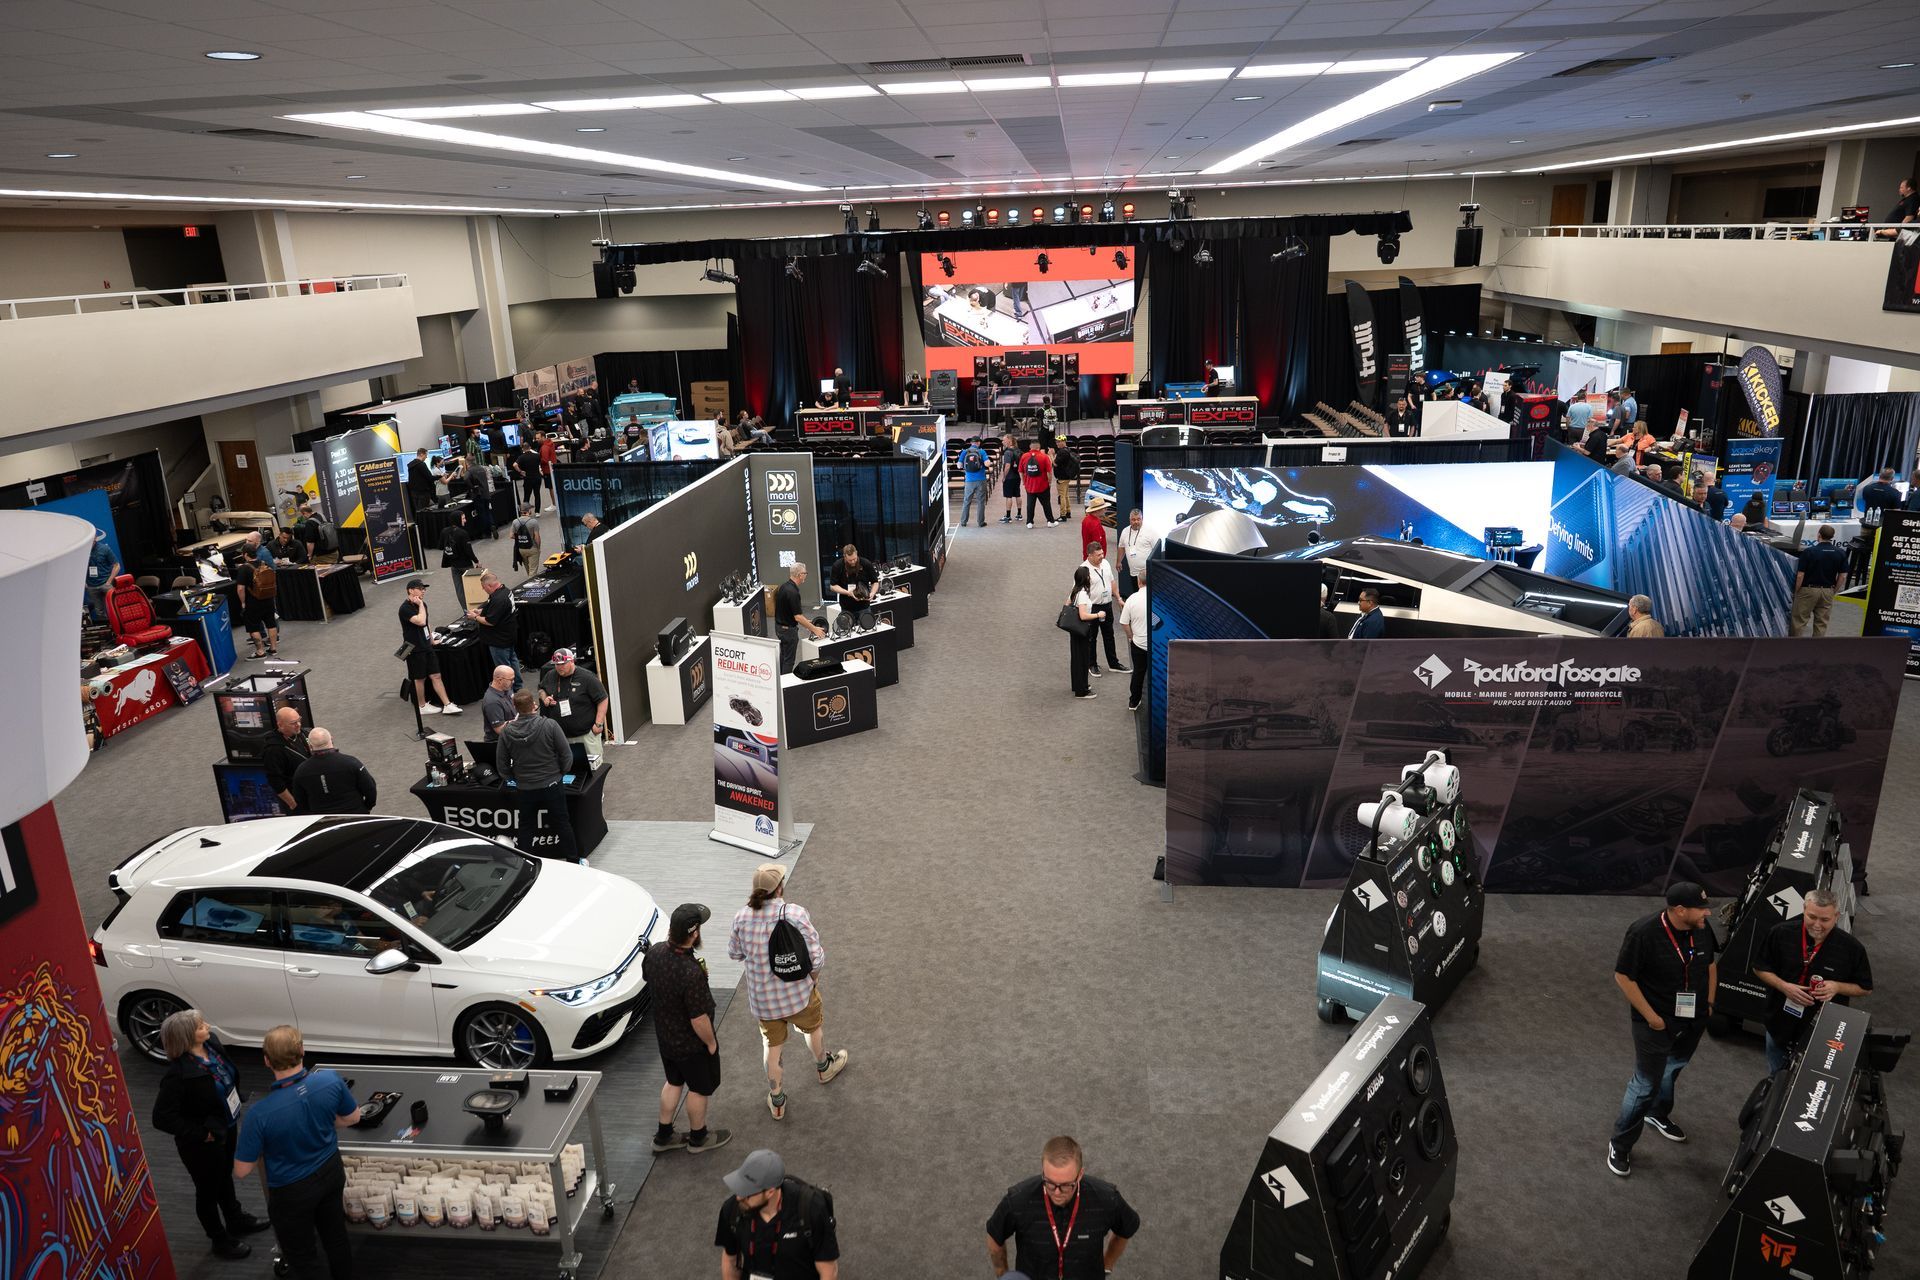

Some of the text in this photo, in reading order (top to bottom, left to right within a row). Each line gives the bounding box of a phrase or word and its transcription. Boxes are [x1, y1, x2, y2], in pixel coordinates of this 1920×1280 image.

[1354, 320, 1377, 378] trulli
[1404, 316, 1424, 372] trulli
[1749, 371, 1780, 431] KICKER
[1191, 411, 1254, 421] EXPO
[804, 421, 855, 432] EXPO
[1527, 421, 1551, 429] SINCE
[339, 468, 347, 478] 3D
[359, 461, 394, 472] CAMaster
[563, 476, 622, 491] audisn
[744, 467, 752, 512] MUSIC
[769, 491, 797, 501] morel
[771, 508, 798, 526] 50
[1547, 514, 1594, 562] Defying limits
[375, 556, 412, 568] MASTERTECH
[376, 560, 413, 575] EXPO
[1878, 608, 1917, 619] Learn Cool
[1880, 614, 1895, 622] Win
[1897, 616, 1913, 625] Cool
[714, 646, 746, 661] ESCORT
[1463, 657, 1643, 688] Rockford Fosgate
[816, 694, 847, 718] 50
[717, 779, 726, 787] THE
[726, 782, 746, 793] DRIVING
[729, 790, 775, 811] AWAKENED
[755, 825, 775, 837] MSC
[1738, 981, 1767, 992] PURPOSE
[1834, 1020, 1847, 1042] ROCKY
[1823, 1047, 1837, 1071] RIDGE
[1367, 1075, 1385, 1102] AUDIO
